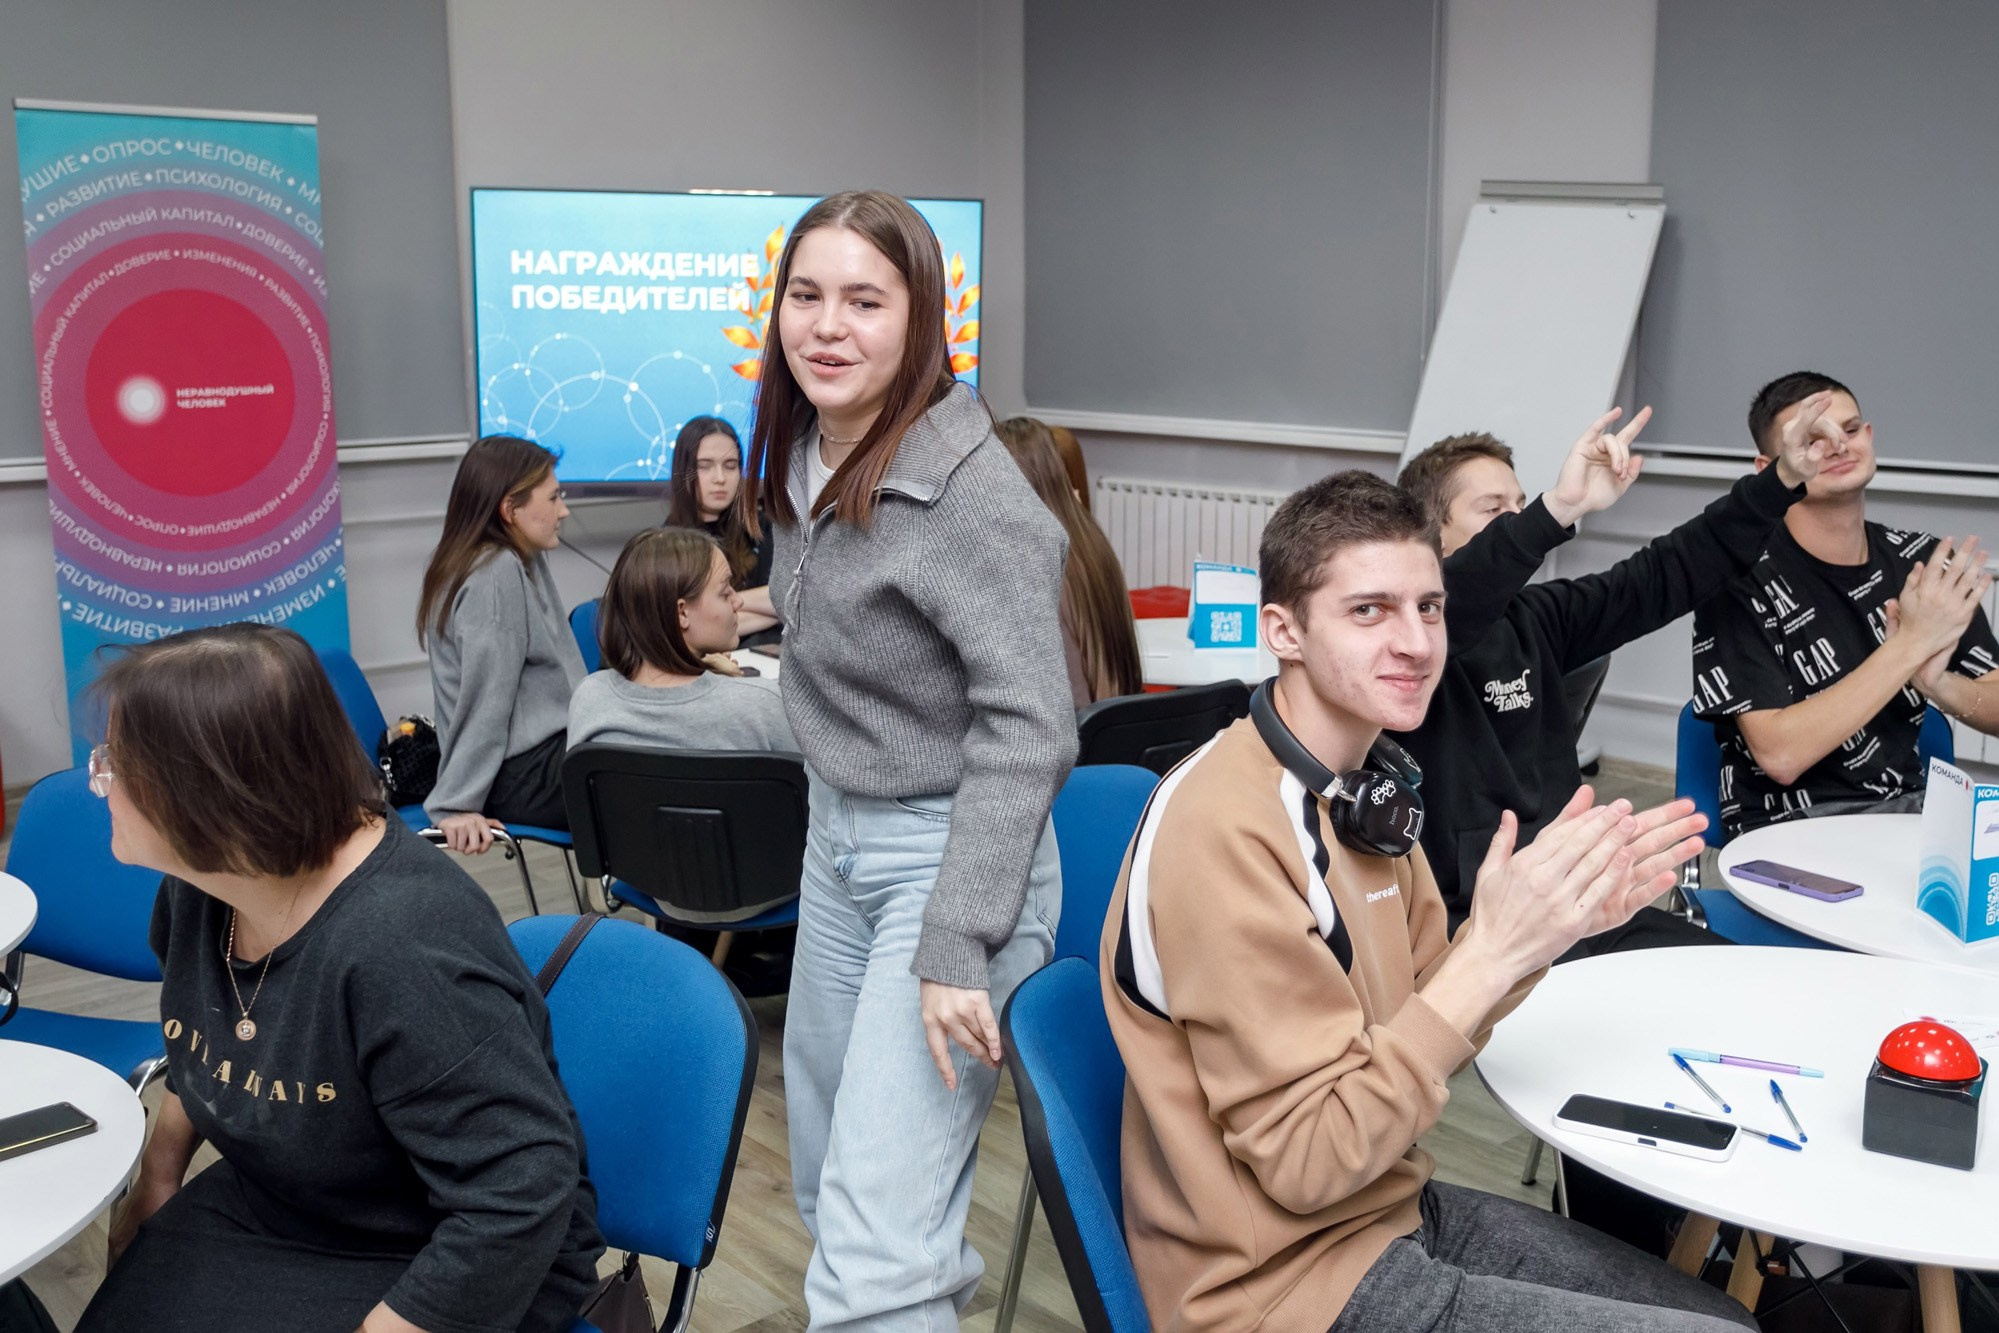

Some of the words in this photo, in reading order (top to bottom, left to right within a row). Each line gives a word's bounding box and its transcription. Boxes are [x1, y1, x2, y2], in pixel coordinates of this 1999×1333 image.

[93, 138, 172, 163] ОПРОС
[186, 140, 285, 182] ЧЕЛОВЕК
[45, 171, 143, 217] РАЗВИТИЕ
[155, 168, 283, 211] ПСИХОЛОГИЯ
[50, 207, 157, 266] СОЦИАЛЬНЫЙ
[161, 207, 234, 227] КАПИТАЛ
[242, 223, 309, 272] ДОВЕРИЕ
[114, 248, 172, 276] ДОВЕРИЕ
[182, 248, 258, 278] ИЗМЕНЕНИЯ
[510, 250, 759, 281] НАГРАЖДЕНИЕ
[65, 274, 111, 318] КАПИТАЛ
[265, 278, 311, 328] РАЗВИТИЕ
[512, 282, 750, 314] ПОБЕДИТЕЛЕЙ
[40, 315, 69, 409] СОЦИАЛЬНЫЙ
[309, 332, 331, 413] ПСИХОЛОГИЯ
[176, 383, 274, 398] НЕРАВНОДУШНЫЙ
[176, 398, 227, 409] ЧЕЛОВЕК
[45, 418, 77, 472] МНЕНИЕ
[285, 420, 329, 495] СОЦИОЛОГИЯ
[78, 476, 128, 520] ЧЕЛОВЕК
[187, 496, 281, 536] НЕРАВНОДУШИЕ
[290, 476, 341, 541] ХОЛОГИЯ
[134, 514, 180, 535] ОПРОС
[177, 540, 281, 576] СОЦИОЛОГИЯ
[263, 544, 337, 596] ЧЕЛОВЕК
[169, 590, 249, 613] МНЕНИЕ
[1793, 637, 1841, 686] GAP
[1931, 764, 1963, 786] КОМАНДА
